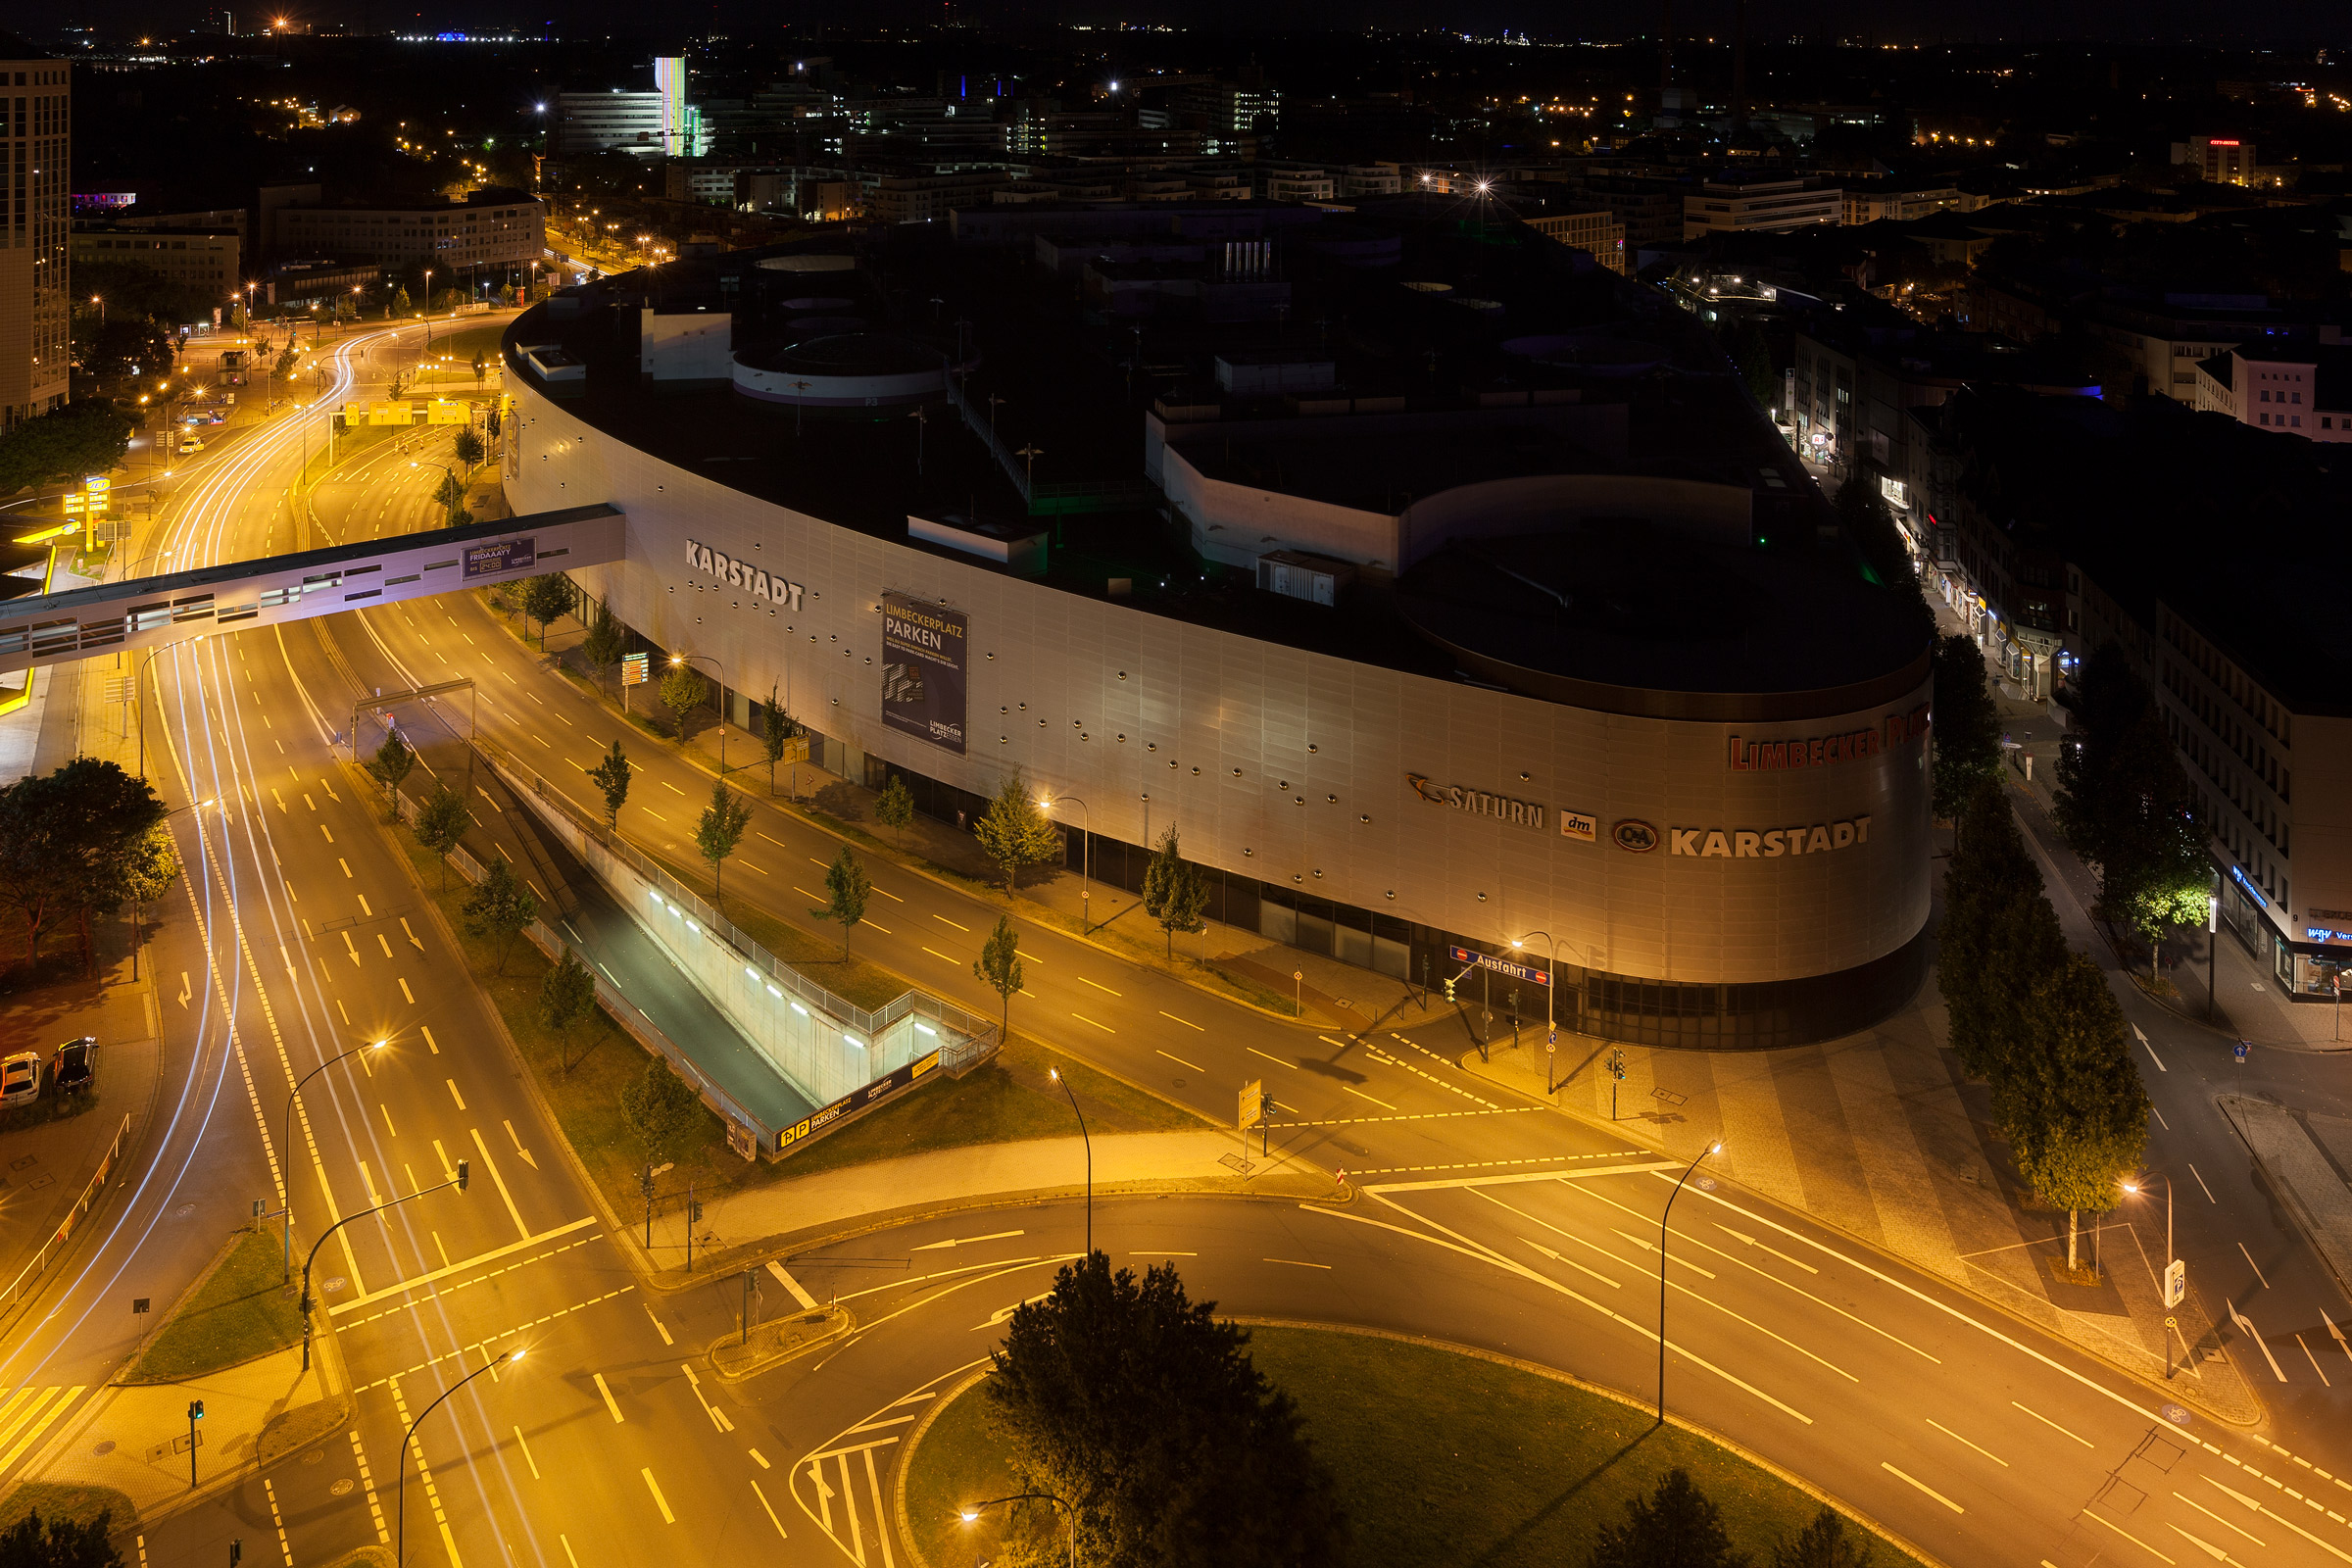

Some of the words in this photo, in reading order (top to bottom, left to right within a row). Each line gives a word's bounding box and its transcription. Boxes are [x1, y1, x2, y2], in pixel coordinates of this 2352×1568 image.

[864, 397, 878, 407] P3
[469, 549, 512, 562] FRIDAAAYY
[685, 538, 805, 612] KARSTADT
[886, 603, 963, 638] LIMBECKERPLATZ
[886, 616, 941, 651] PARKEN
[929, 719, 962, 738] LIMBECKER
[1730, 729, 1881, 772] LIMBECKER
[1449, 786, 1544, 829] SATURN
[1568, 815, 1591, 832] dm
[1671, 815, 1872, 858] KARSTADT
[2292, 913, 2298, 922] 9
[1477, 955, 1527, 978] Ausfahrt
[810, 1097, 852, 1122] LIMBECKERPLATZ
[810, 1107, 841, 1129] PARKEN
